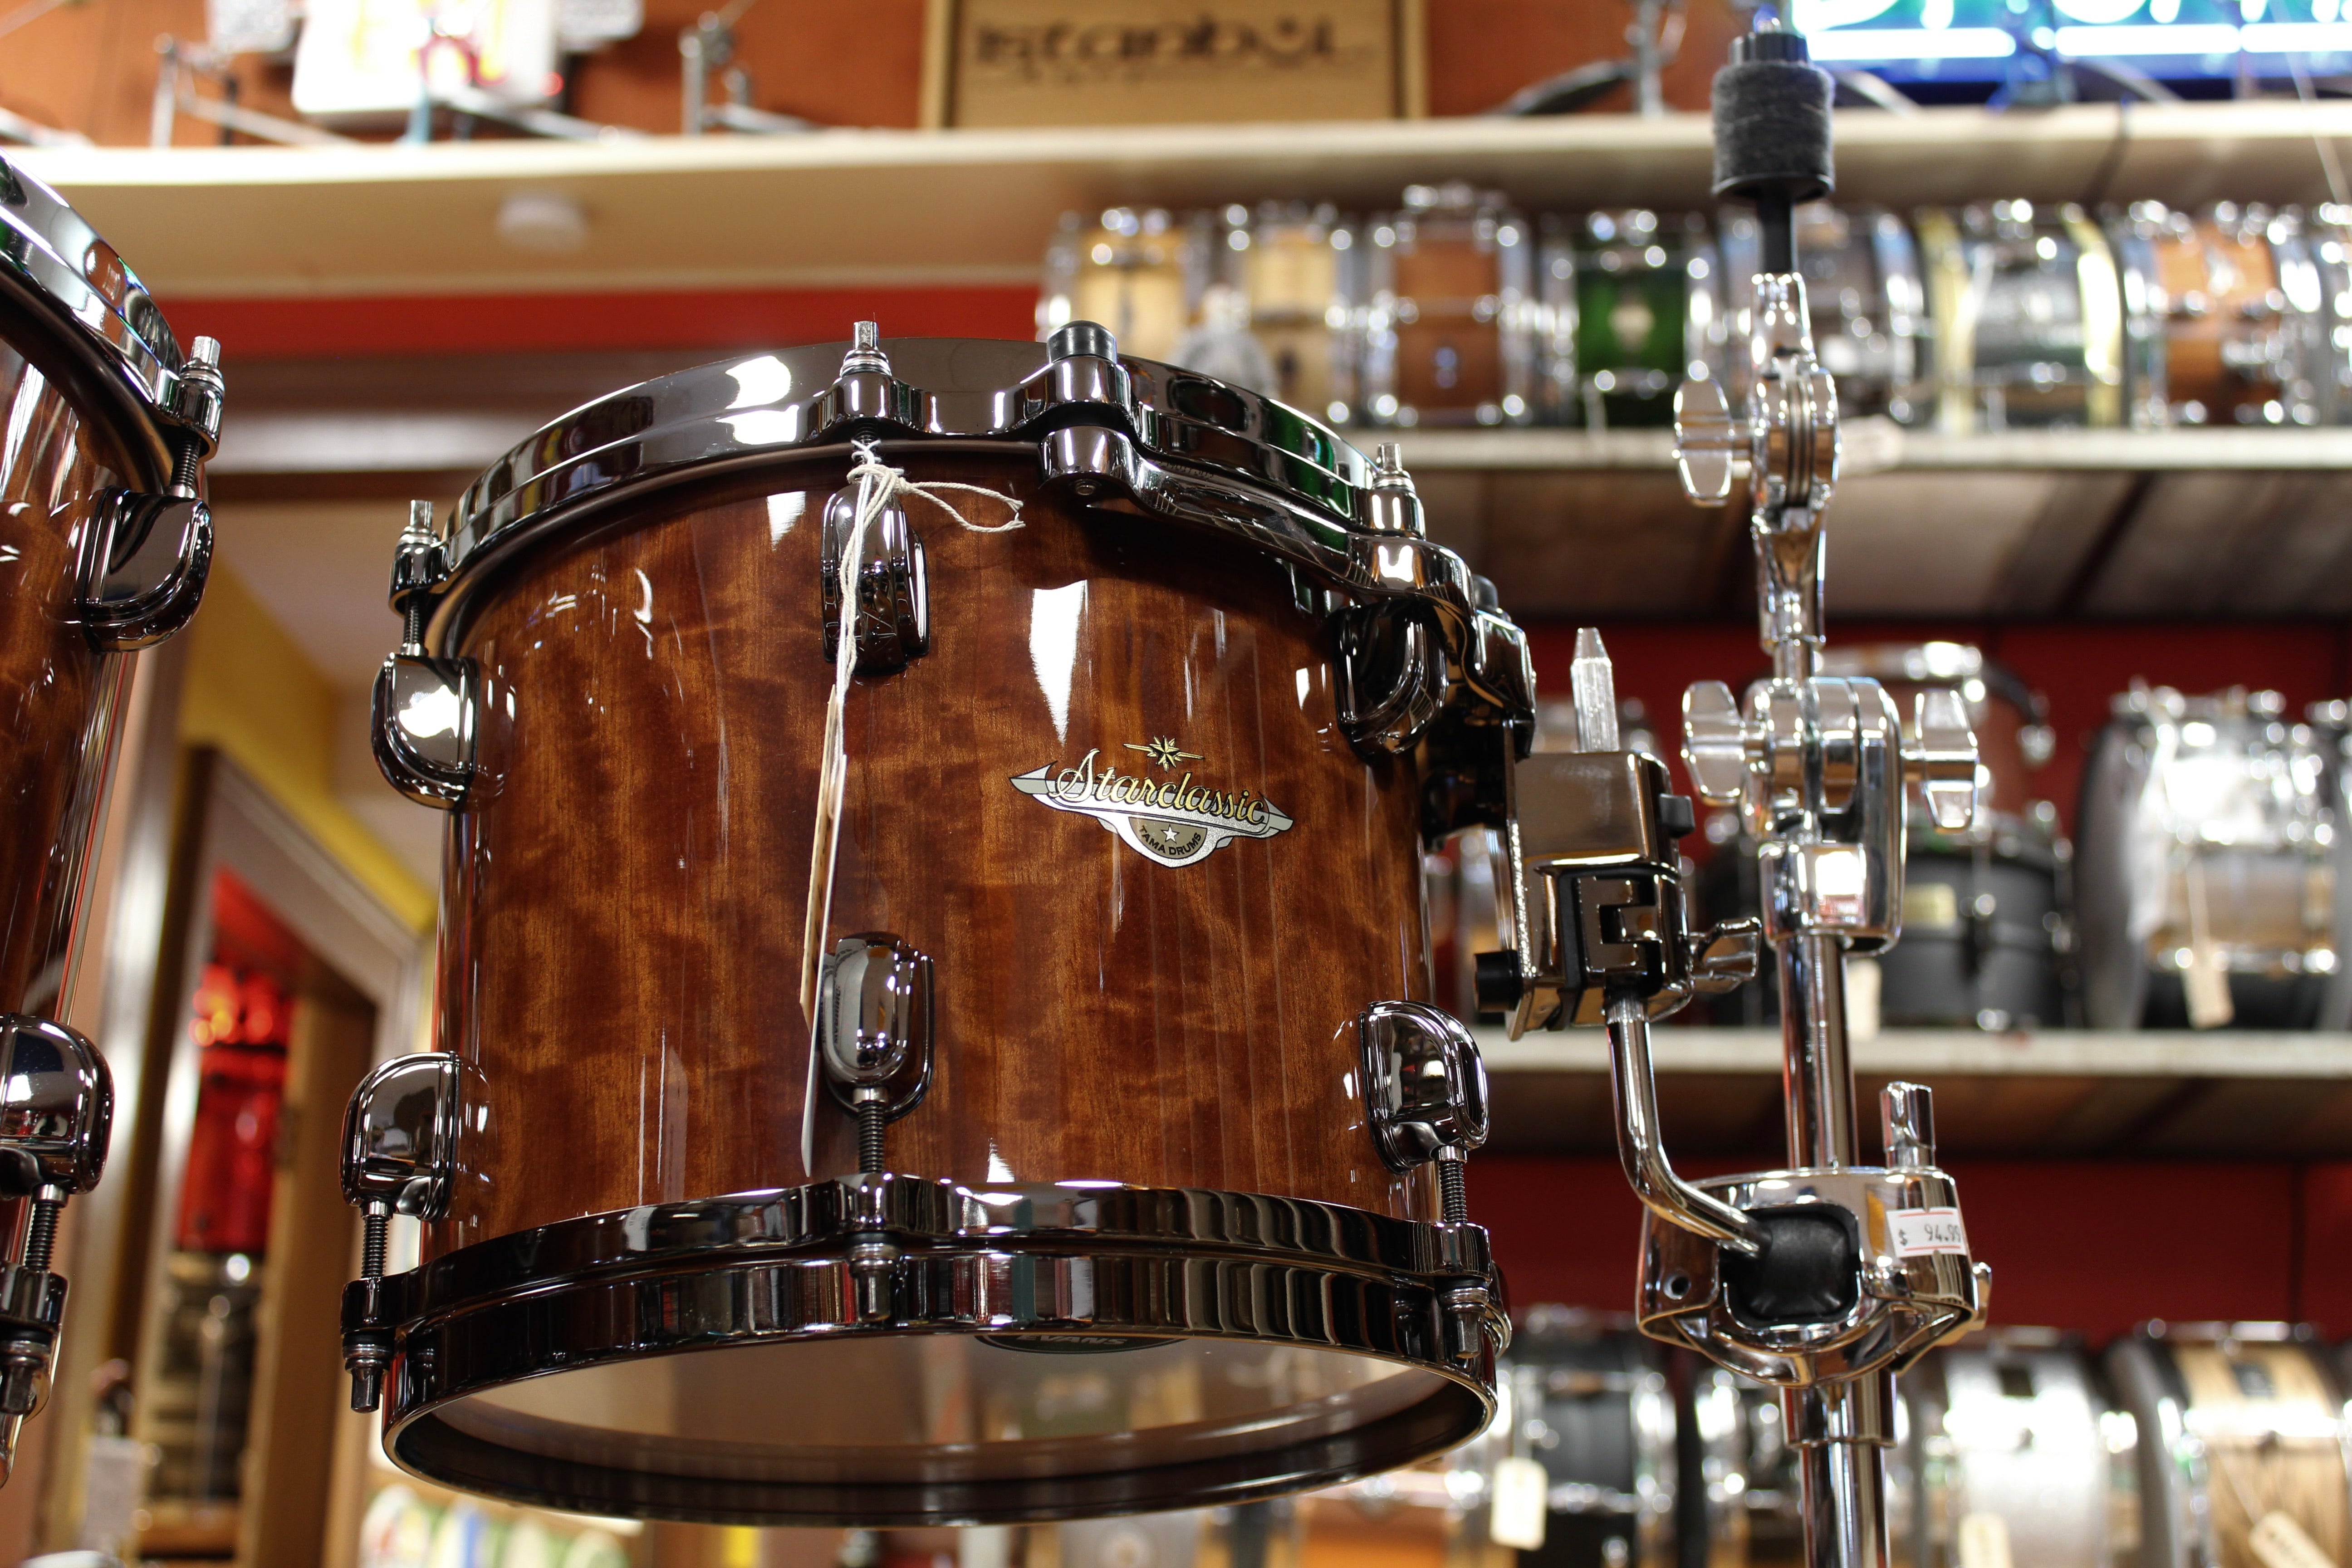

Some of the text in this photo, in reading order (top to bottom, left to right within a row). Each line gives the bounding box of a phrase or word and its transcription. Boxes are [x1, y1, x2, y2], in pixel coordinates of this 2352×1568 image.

[1050, 748, 1264, 824] Starclassic
[1139, 825, 1202, 856] TAMA DRUMS
[1925, 1224, 1961, 1243] 94.99
[1016, 1335, 1127, 1344] EVANS
